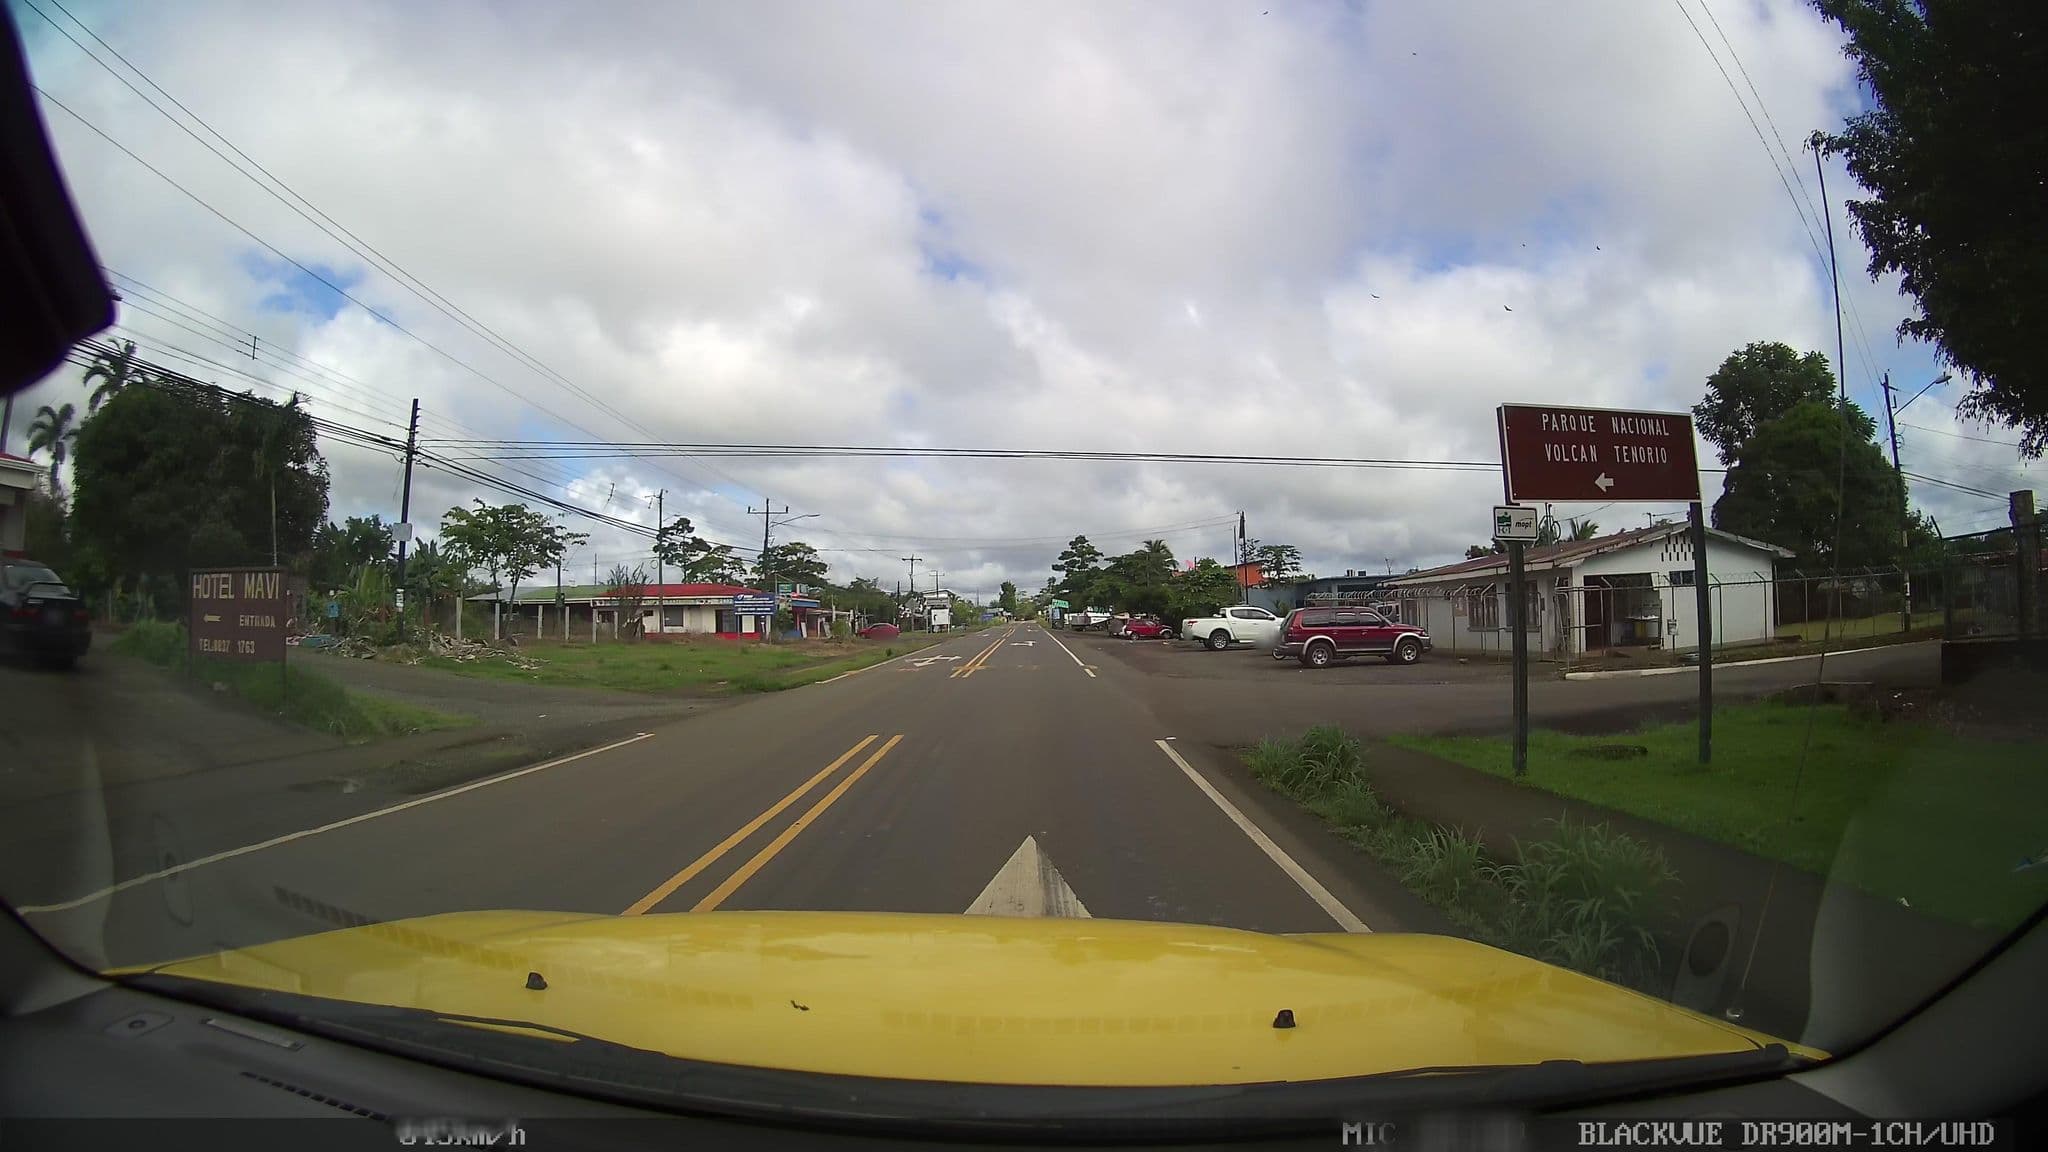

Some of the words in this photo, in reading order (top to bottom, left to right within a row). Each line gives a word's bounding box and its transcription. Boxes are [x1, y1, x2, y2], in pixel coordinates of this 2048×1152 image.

[1542, 413, 1596, 432] PARQUE
[1611, 416, 1670, 436] NACIONAL
[1544, 442, 1598, 463] VOLCAN
[1614, 445, 1668, 464] TENORIO
[192, 573, 235, 599] HOTEL
[244, 572, 280, 599] MAVI
[239, 614, 276, 628] ENTRADA
